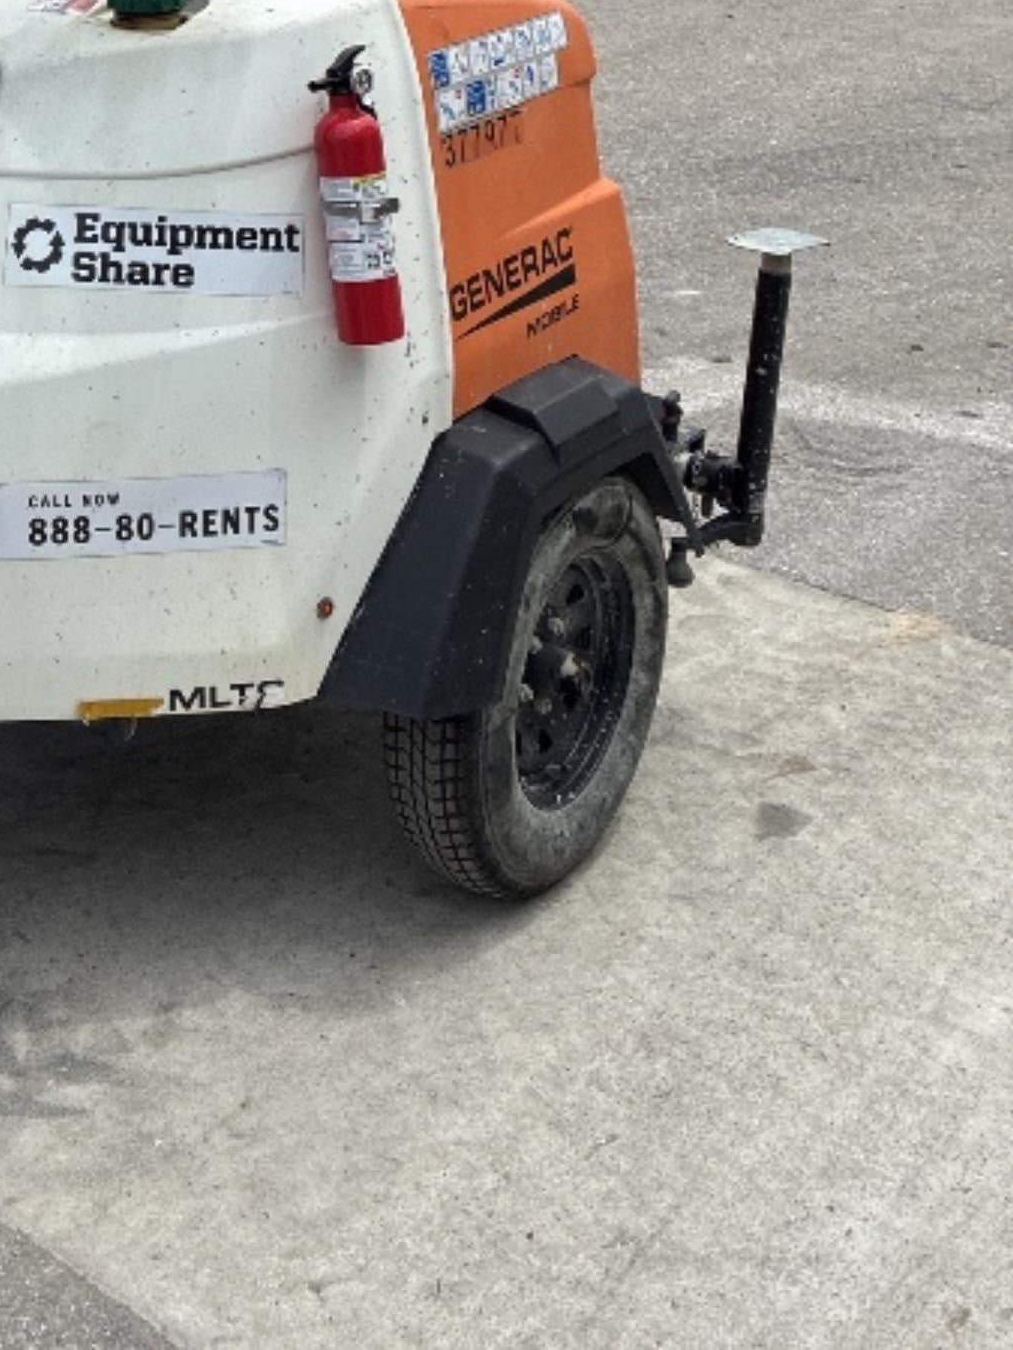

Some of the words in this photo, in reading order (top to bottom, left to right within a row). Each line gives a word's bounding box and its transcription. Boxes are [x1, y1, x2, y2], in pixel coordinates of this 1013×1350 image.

[73, 212, 301, 256] Equipment
[71, 251, 196, 288] Share
[449, 226, 574, 322] GENERAC
[526, 302, 580, 340] MOBILE
[27, 494, 73, 509] CALL
[81, 491, 120, 507] NOW
[28, 503, 280, 547] 888-80-RENTS
